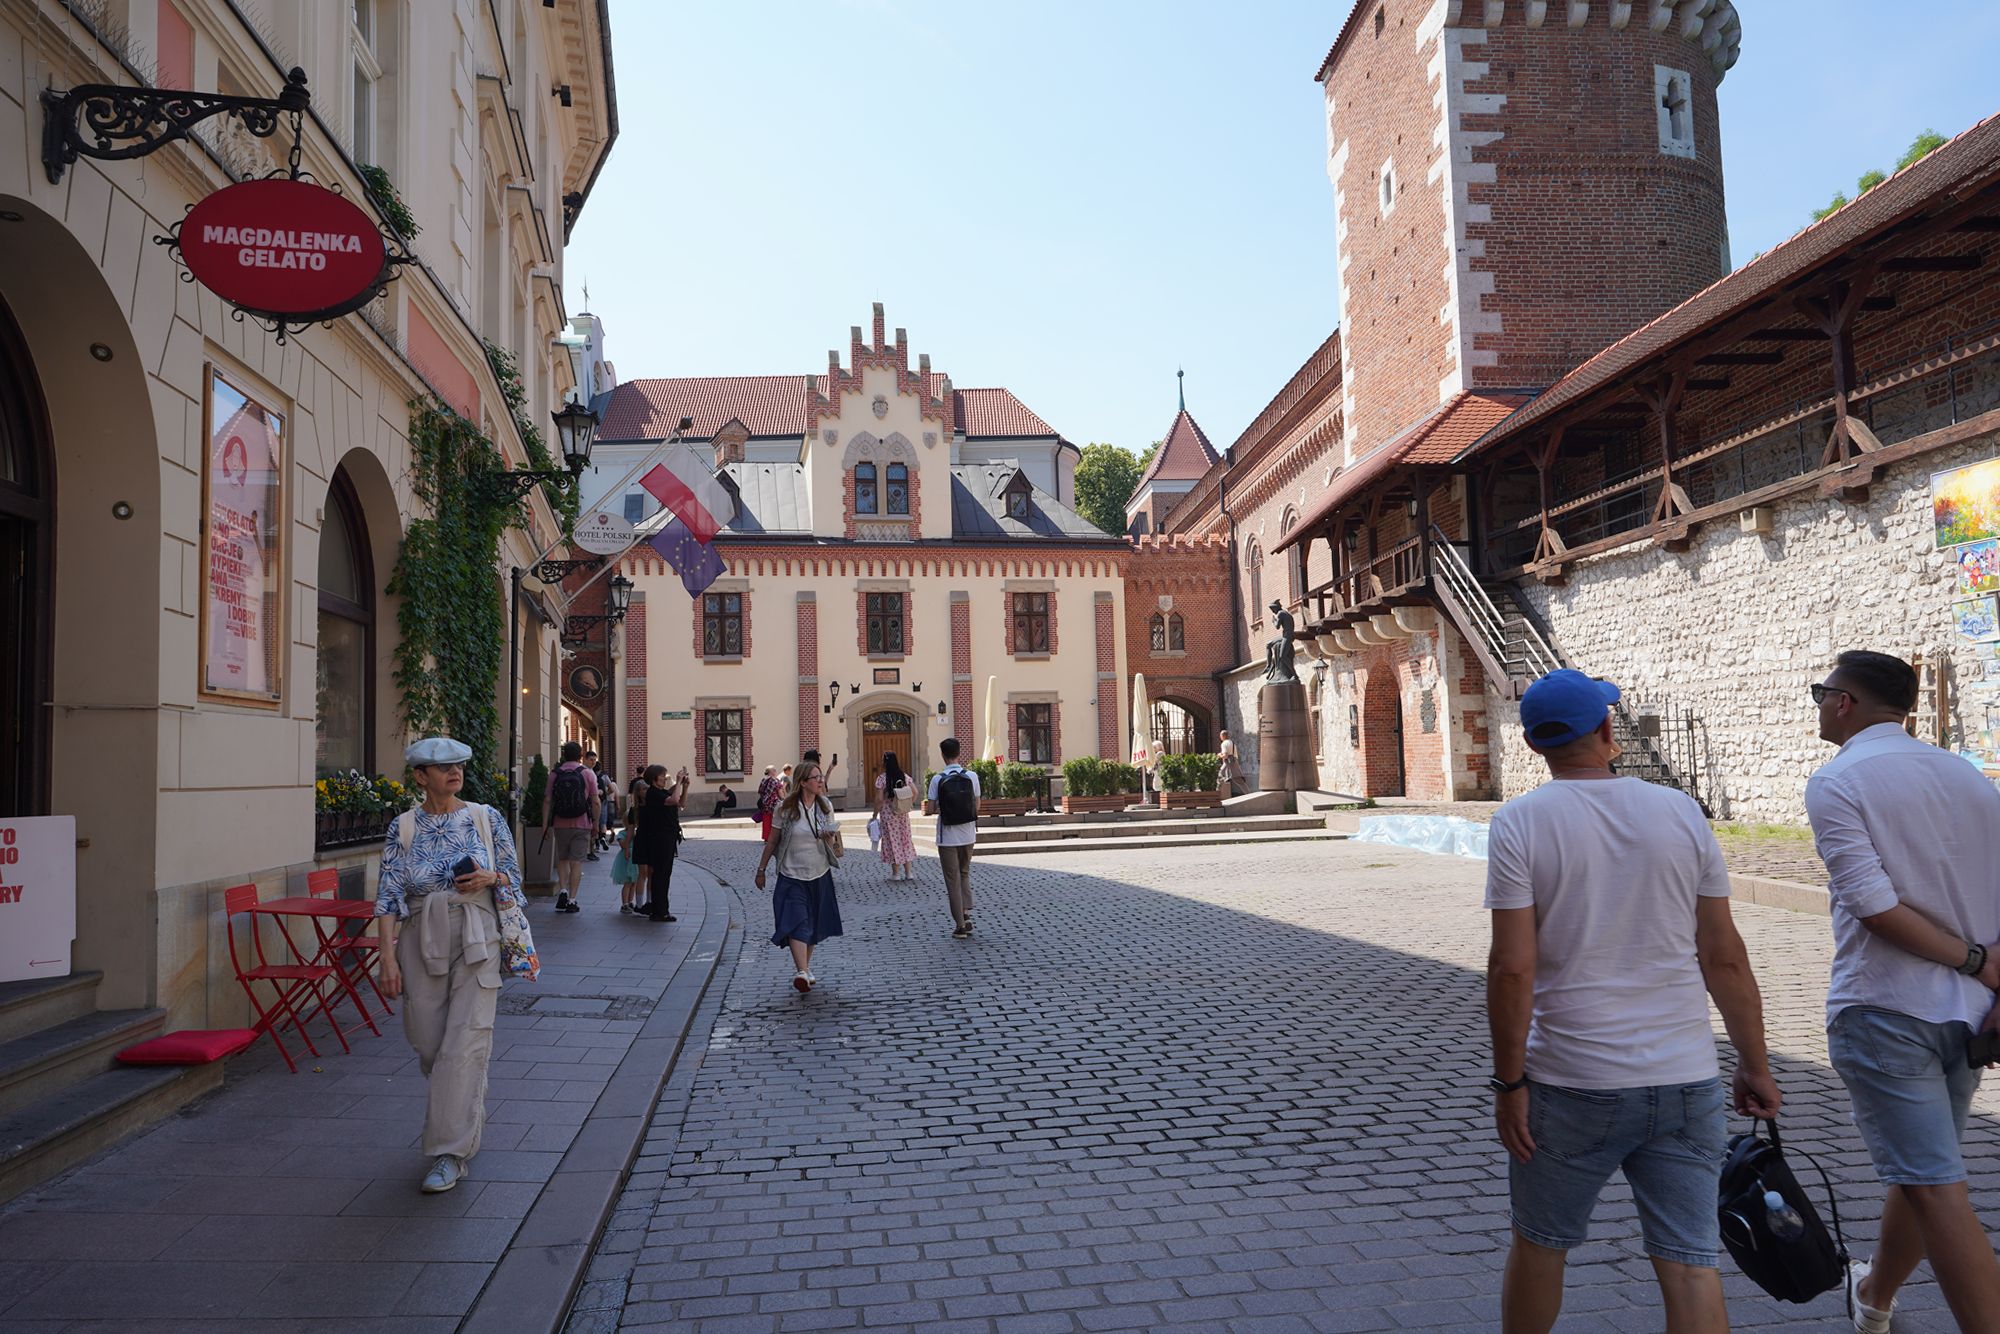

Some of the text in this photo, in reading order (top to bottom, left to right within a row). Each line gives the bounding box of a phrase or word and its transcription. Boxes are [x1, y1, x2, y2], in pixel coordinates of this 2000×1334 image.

[203, 225, 362, 253] MAGDALENKA
[238, 249, 326, 271] GELATO
[576, 424, 589, 441] 17
[574, 531, 631, 540] HOTEL POLSKI
[232, 606, 256, 625] DOBRY
[240, 623, 256, 641] VIBE
